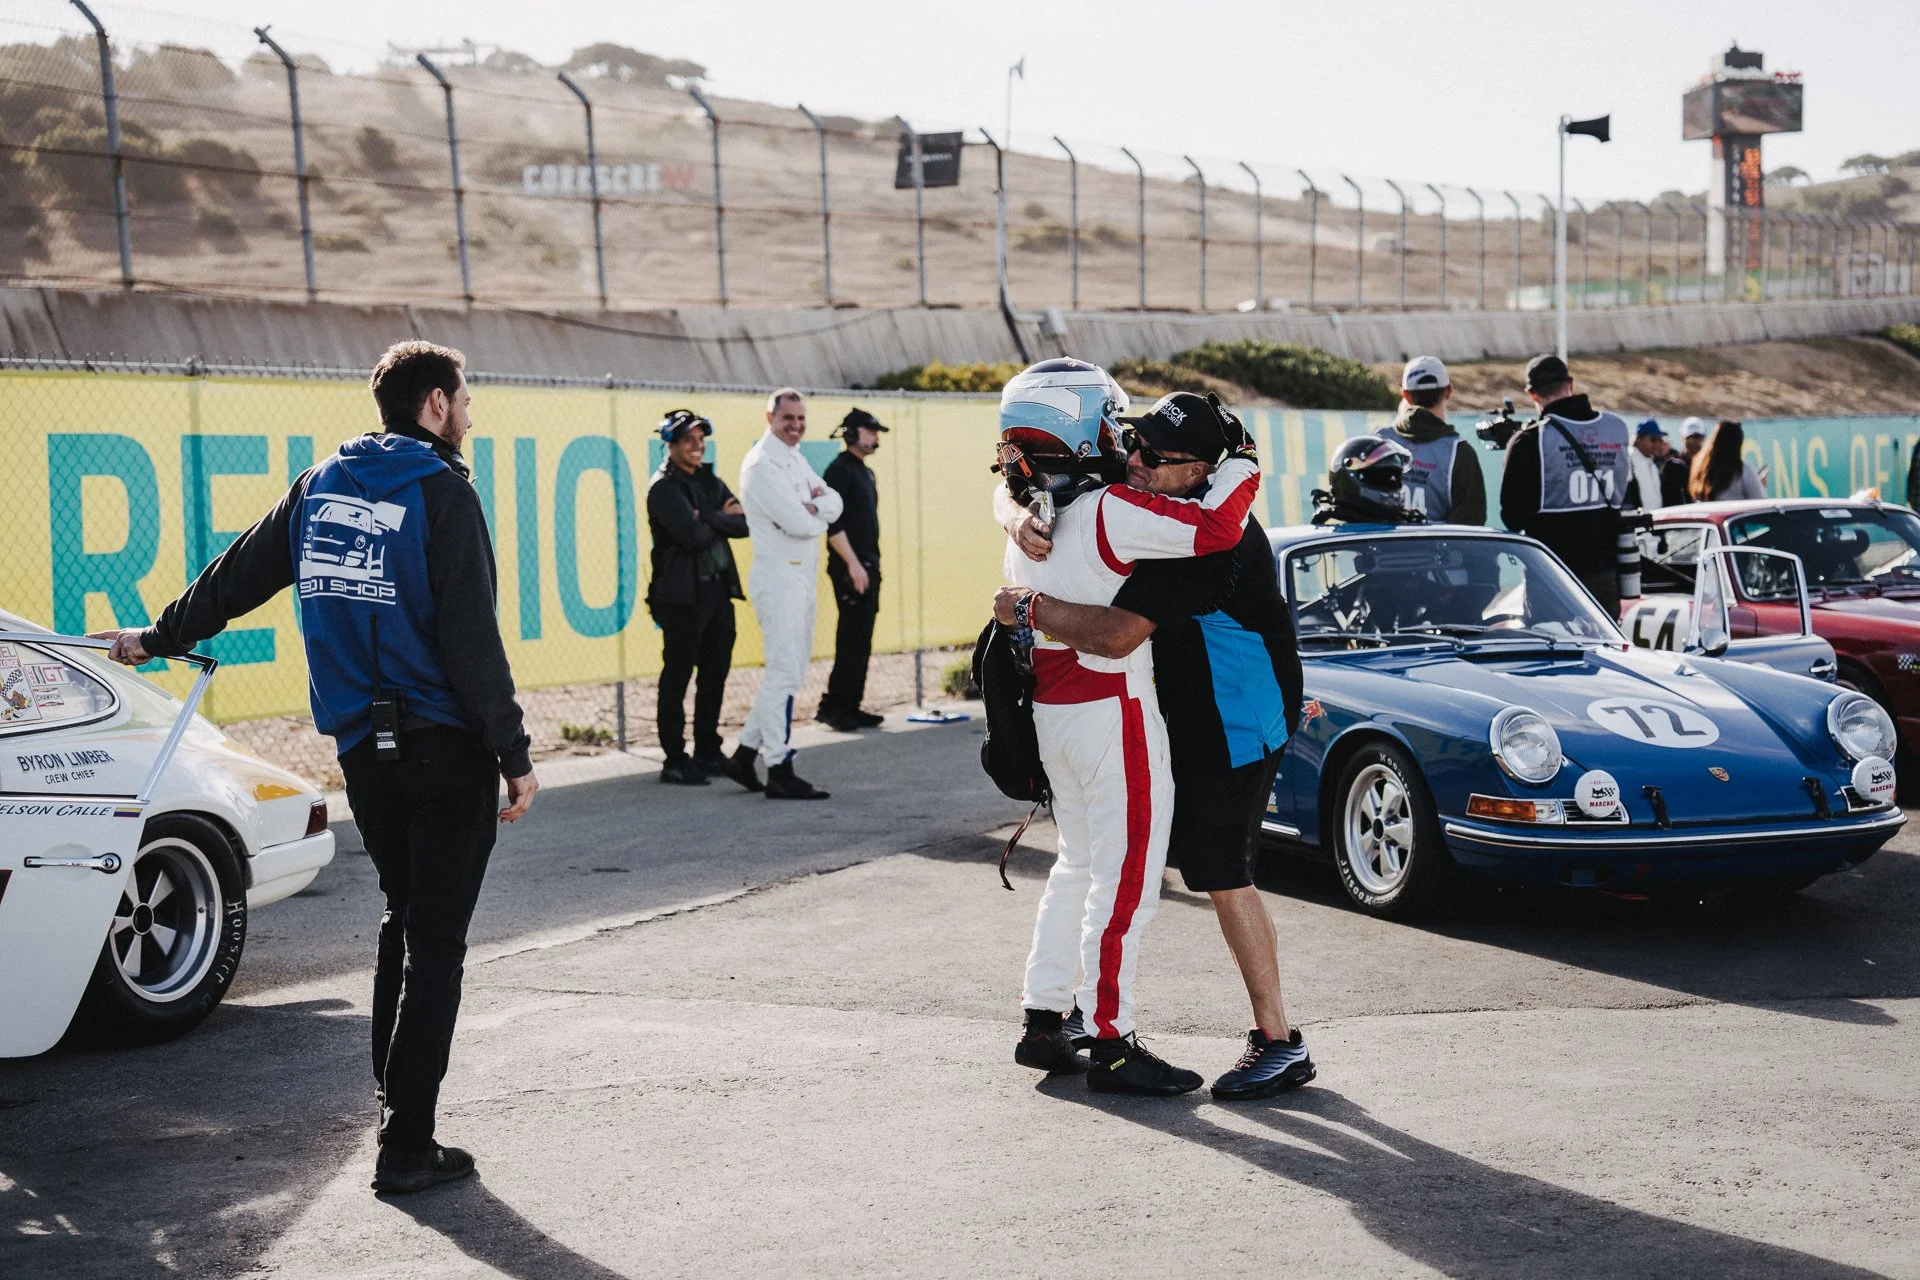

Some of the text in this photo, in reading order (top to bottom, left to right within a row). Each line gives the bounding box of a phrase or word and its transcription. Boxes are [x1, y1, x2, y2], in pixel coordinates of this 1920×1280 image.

[1569, 470, 1614, 504] 071
[47, 432, 717, 674] REIO
[330, 580, 396, 598] SHOP
[42, 666, 64, 682] GT
[1600, 704, 1708, 738] 72
[17, 749, 115, 772] BYRON LIMBER
[45, 769, 96, 785] CREW CHIEF
[56, 804, 112, 817] CALLE
